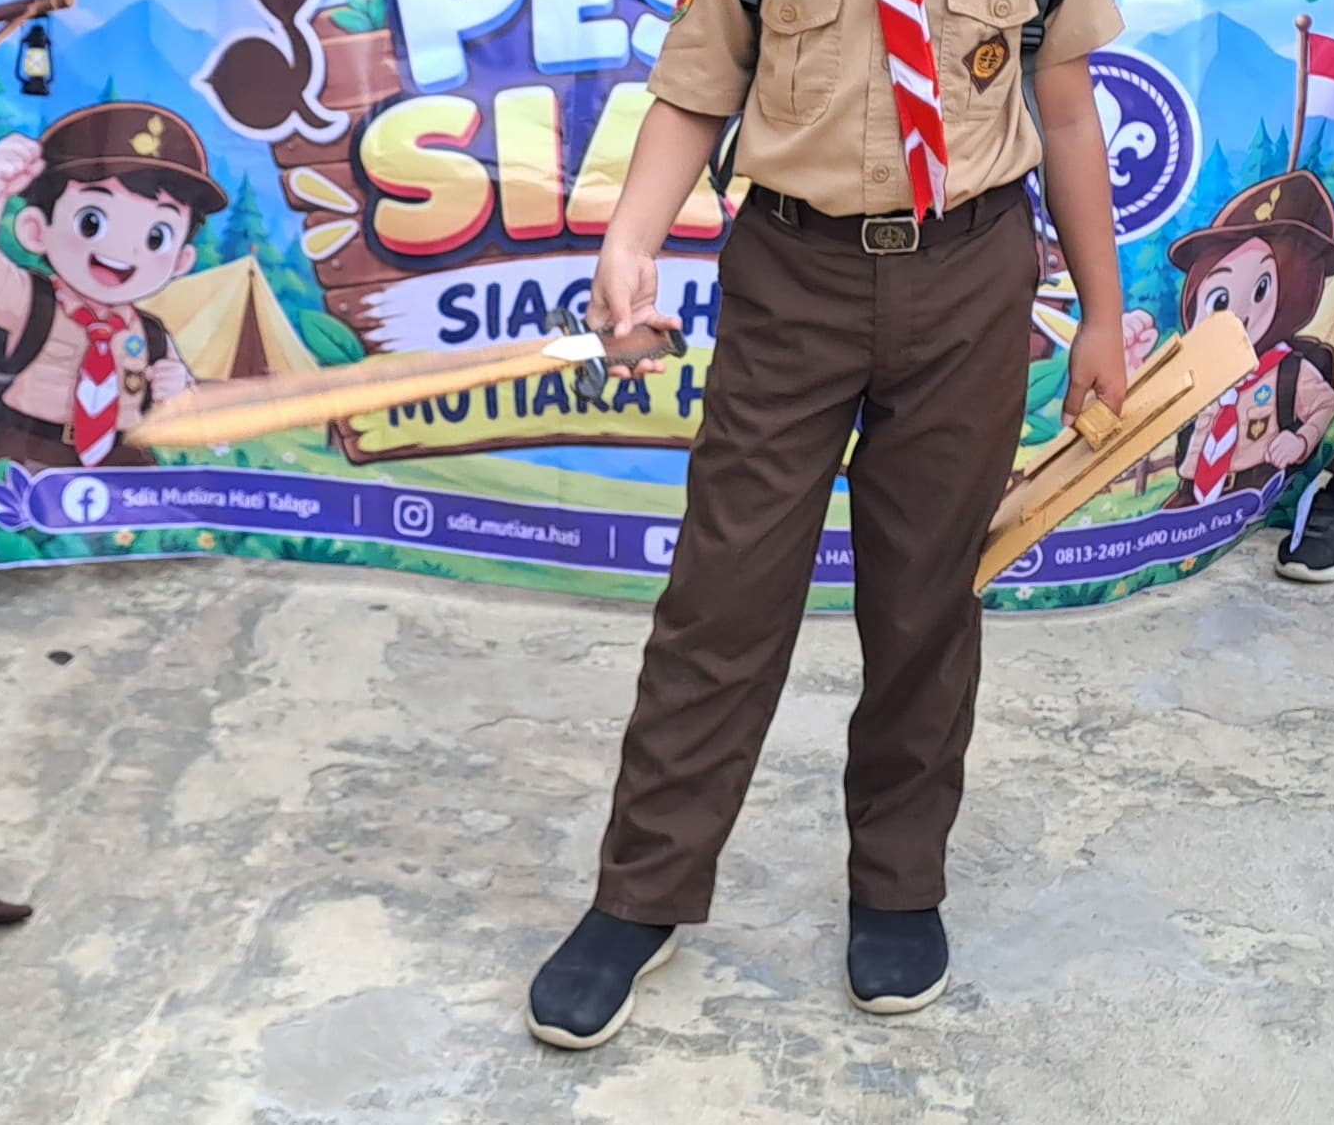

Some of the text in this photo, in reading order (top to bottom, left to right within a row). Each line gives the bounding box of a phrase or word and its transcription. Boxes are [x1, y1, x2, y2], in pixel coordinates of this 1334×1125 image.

[360, 82, 751, 255] SIA
[437, 278, 721, 344] SIAG H
[122, 486, 159, 507] Sdit
[161, 486, 226, 508] Mutiara
[229, 488, 266, 510] Hati
[446, 511, 581, 548] sdit.mutiara.hati
[1055, 529, 1168, 565] 0813-2491-5400
